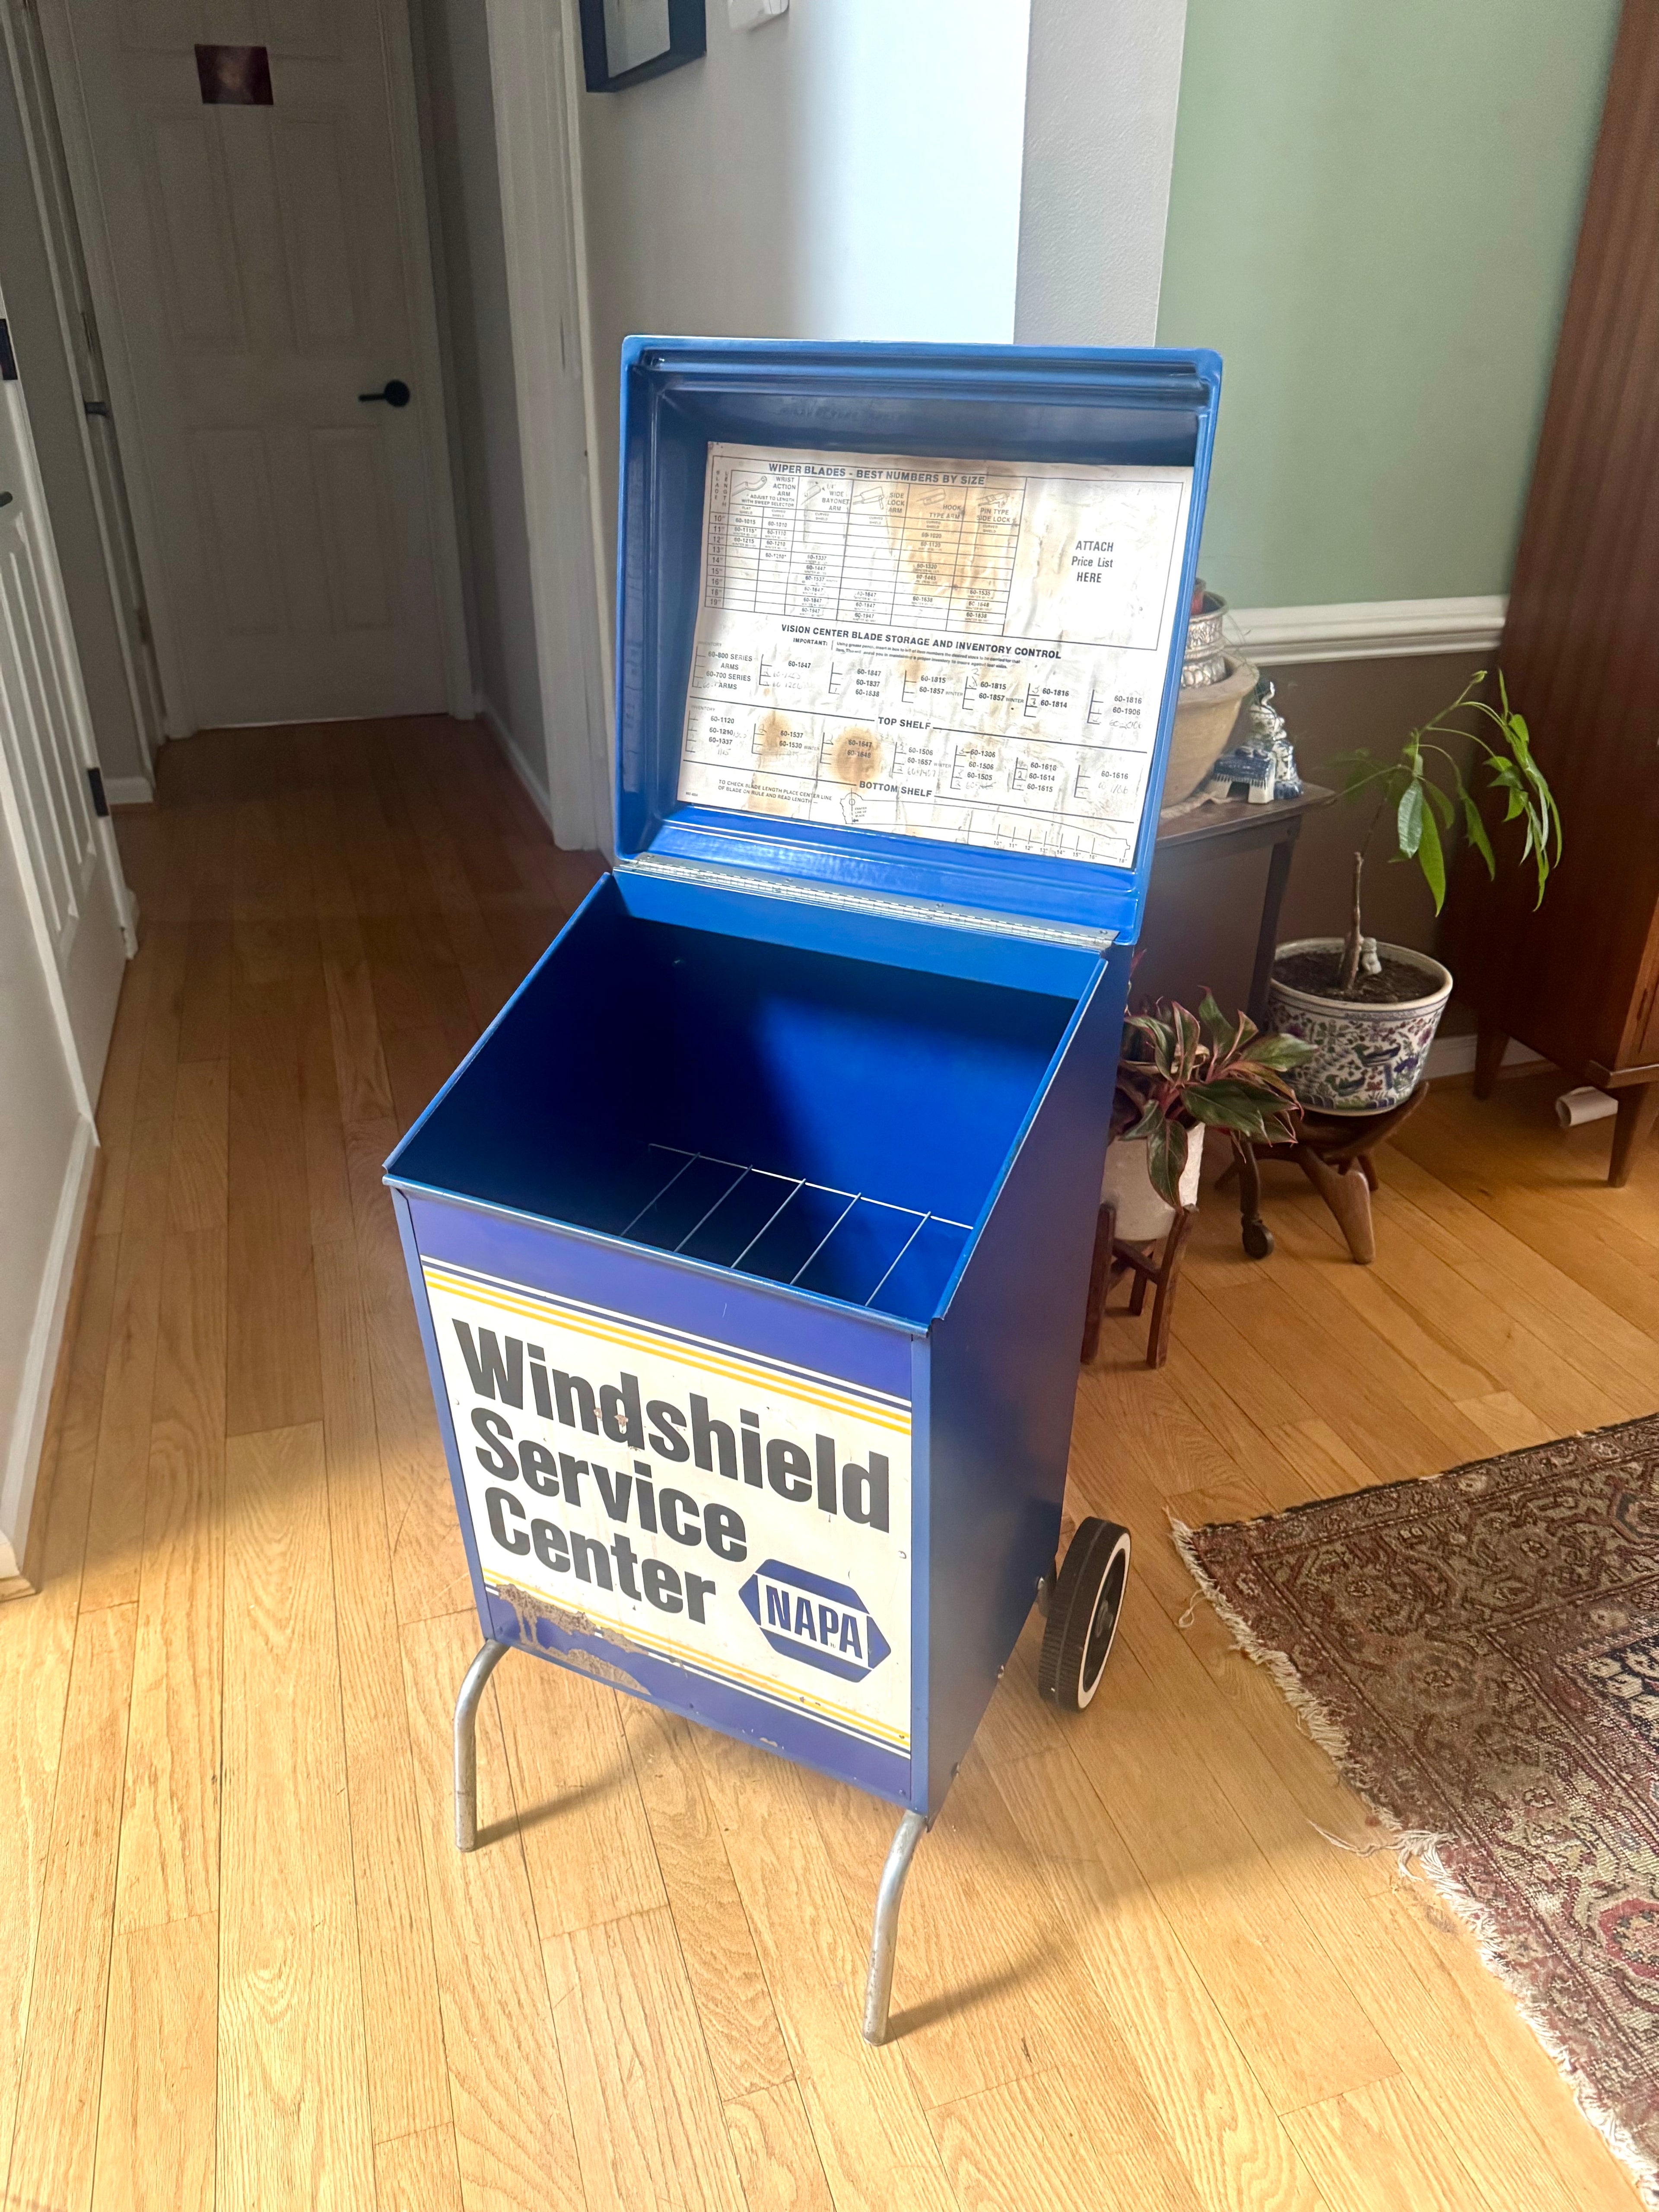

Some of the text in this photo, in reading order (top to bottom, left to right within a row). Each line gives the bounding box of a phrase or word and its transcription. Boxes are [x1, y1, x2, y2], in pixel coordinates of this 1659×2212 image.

[769, 463, 801, 474] WIPER
[804, 467, 845, 477] BLADES
[856, 470, 883, 479] BEST
[886, 471, 939, 483] NUMBERS
[943, 475, 957, 483] BY
[960, 476, 985, 485] SIZE
[1075, 540, 1114, 552] ATTACH
[1071, 556, 1113, 567] Price List
[1077, 572, 1102, 583] HERE
[781, 624, 1062, 659] VISION CENTER BLADE STORAGE AND INVENTORY CONTROL
[708, 651, 728, 659] 60-800
[981, 681, 1006, 690] 60-1815
[1042, 688, 1069, 696] 60-1816
[979, 693, 1005, 701] 60-1857
[1114, 695, 1142, 704] 60-1816
[1040, 700, 1067, 708] 60-1814
[1113, 707, 1141, 715] 60-1906
[878, 717, 931, 730] TOP SHELF
[848, 739, 872, 747] 60-1647
[909, 747, 933, 756] 60-1506
[971, 749, 995, 758] 60-1306
[969, 762, 994, 770] 60-1506
[967, 772, 993, 781] 60-1505
[1101, 771, 1128, 779] 60-1616
[859, 781, 932, 797] BOTTOM SHELF
[1027, 784, 1053, 792] 60-1615
[451, 1318, 890, 1533] Windshield
[470, 1407, 748, 1563] Service
[484, 1486, 716, 1625] Center
[766, 1584, 863, 1660] NAPA
